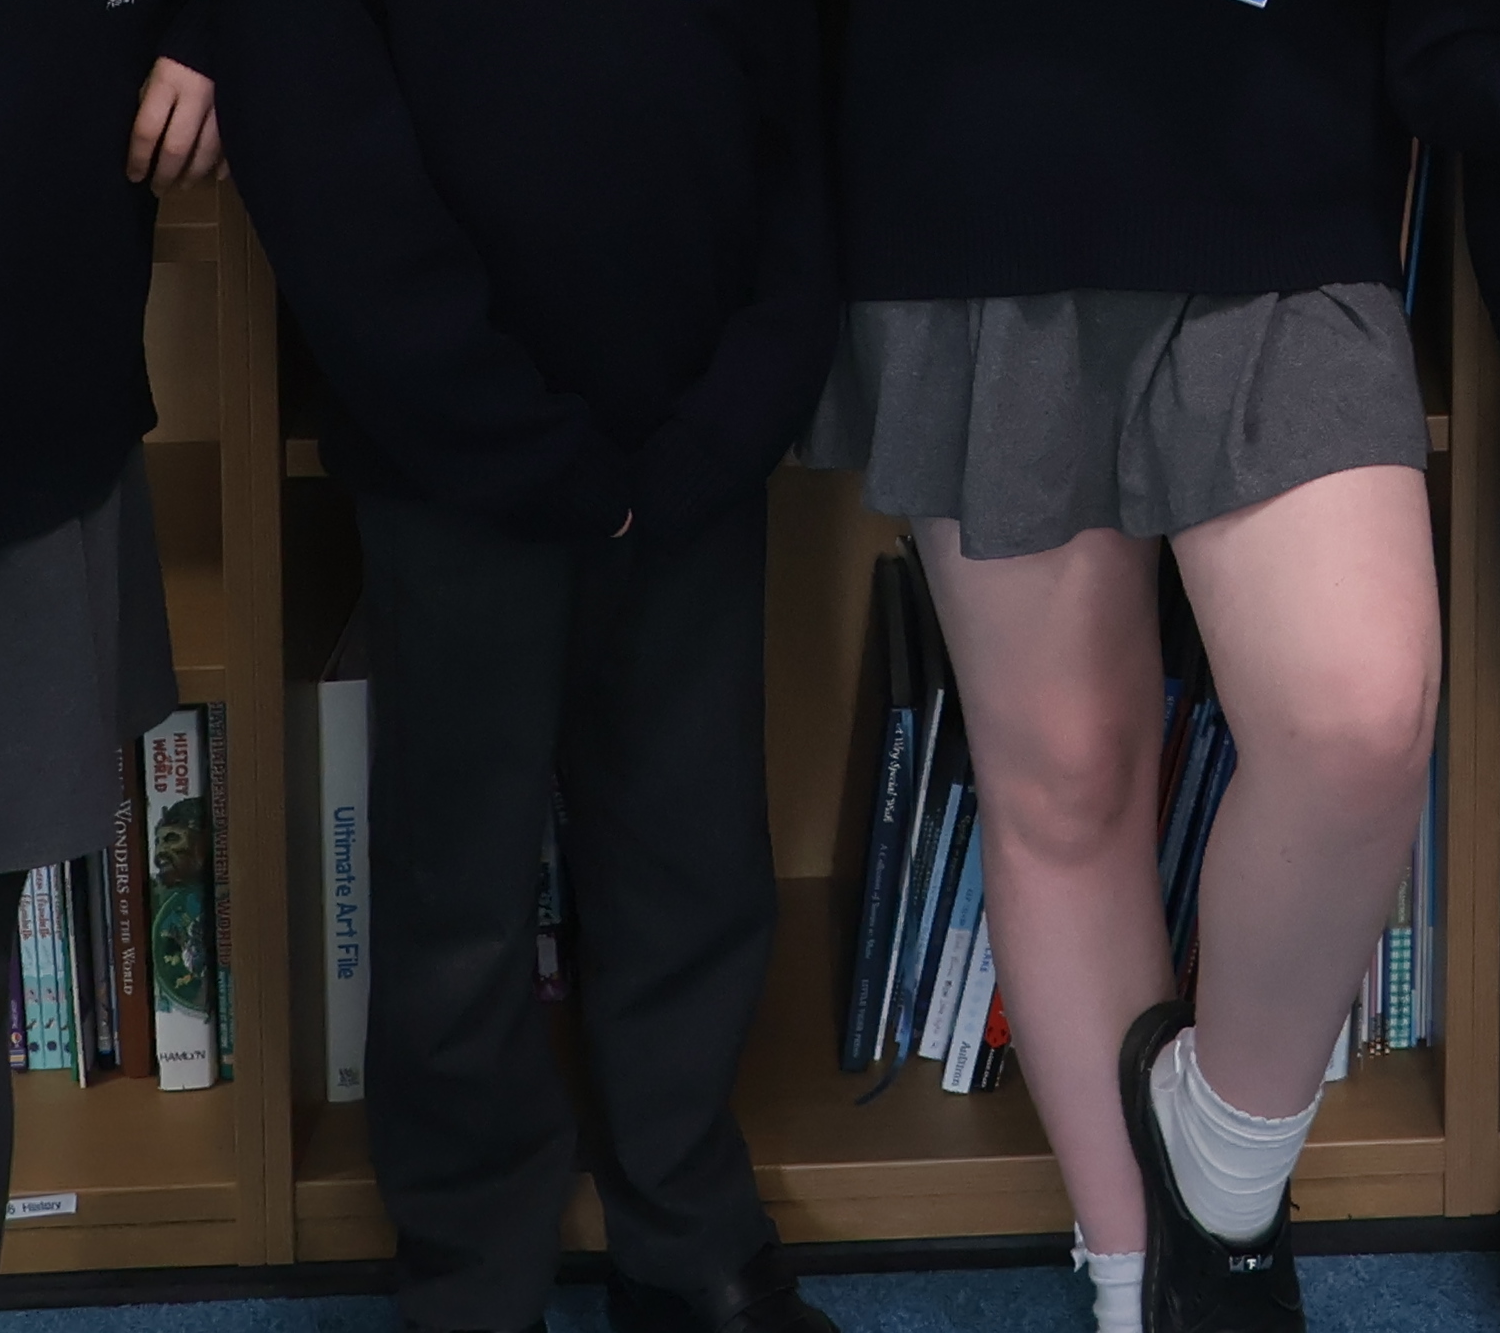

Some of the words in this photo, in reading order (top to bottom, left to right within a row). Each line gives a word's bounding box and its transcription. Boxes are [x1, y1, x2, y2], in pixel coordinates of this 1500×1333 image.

[153, 738, 168, 794] WORLD
[173, 733, 189, 796] HISTORY
[113, 798, 132, 894] WONDERS
[334, 806, 356, 897] Ultimate
[119, 899, 129, 915] OF
[337, 903, 358, 938] Art
[121, 947, 136, 996] WORLD
[338, 942, 358, 981] File
